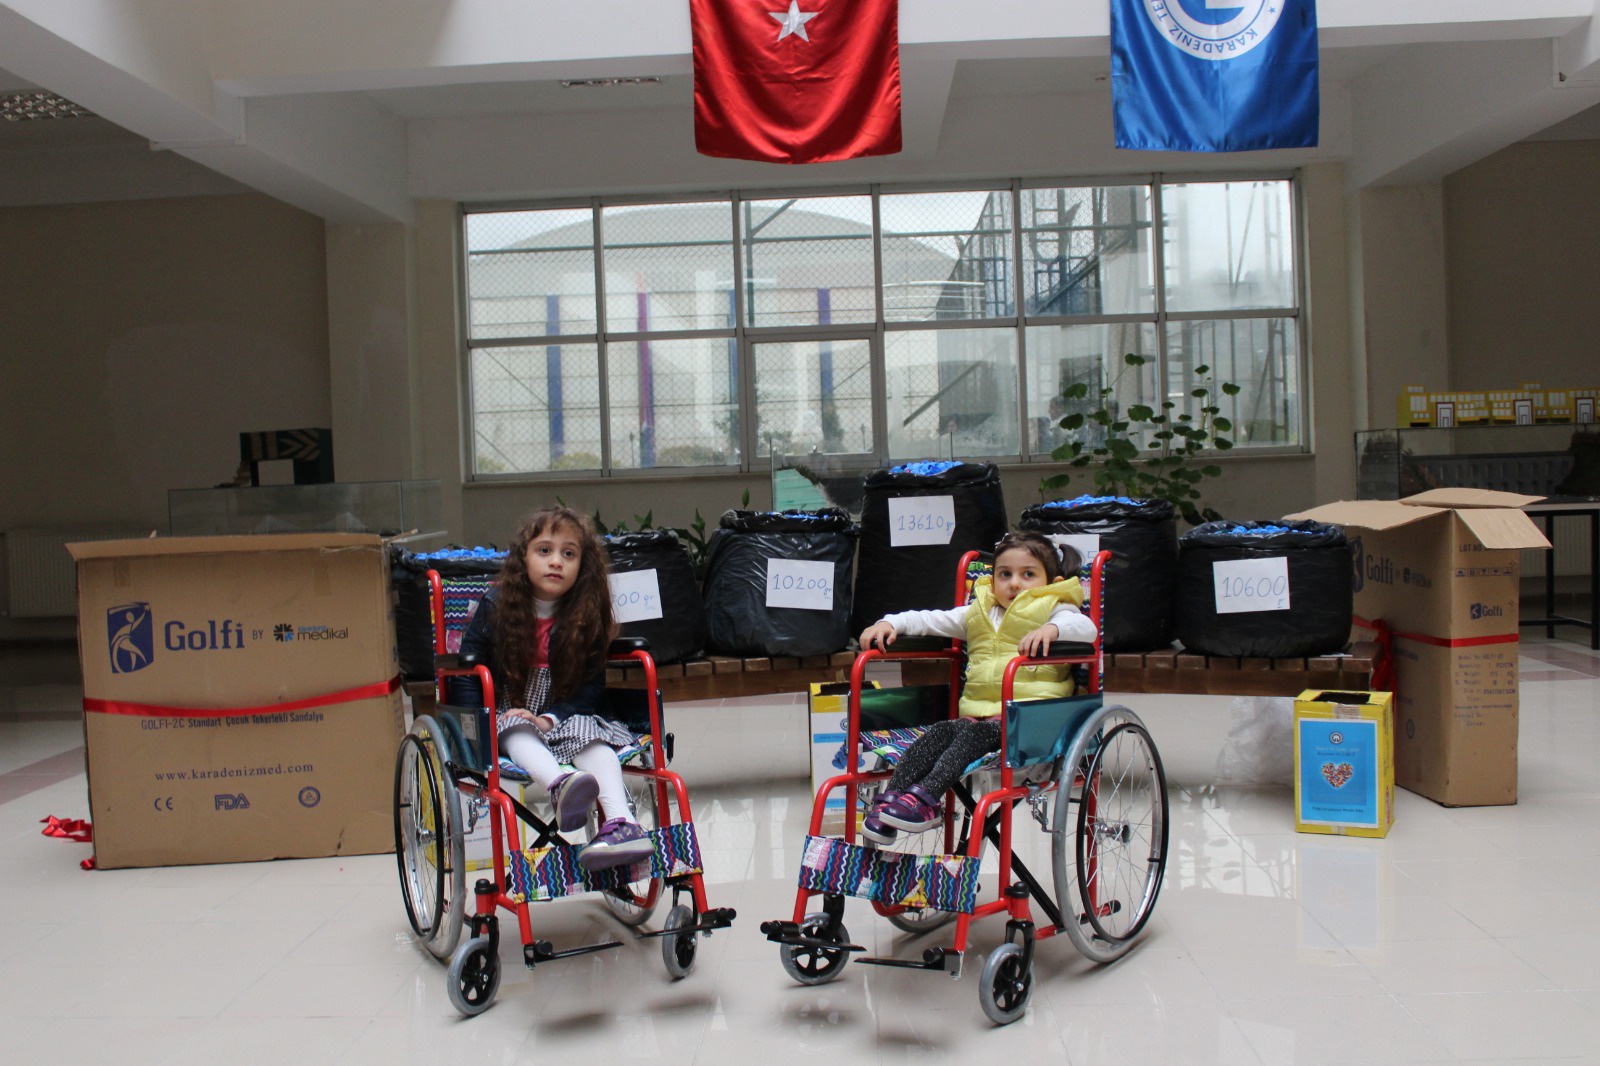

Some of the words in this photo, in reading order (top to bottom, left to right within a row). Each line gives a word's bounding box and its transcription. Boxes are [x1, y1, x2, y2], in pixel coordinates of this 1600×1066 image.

[1169, 24, 1258, 54] KARADENİZ
[897, 514, 944, 531] 13610
[1366, 554, 1394, 585] Golfi
[772, 573, 827, 590] 10200
[1222, 575, 1287, 598] 10600
[612, 591, 640, 607] 00
[1482, 605, 1503, 617] Golfi
[164, 619, 245, 651] Golfi
[252, 629, 264, 640] BY
[297, 627, 349, 642] medikal
[188, 717, 222, 728] Standart
[290, 711, 324, 723] Sandalye
[155, 763, 314, 781] www.karadenizmed.com
[214, 793, 250, 811] FDA
